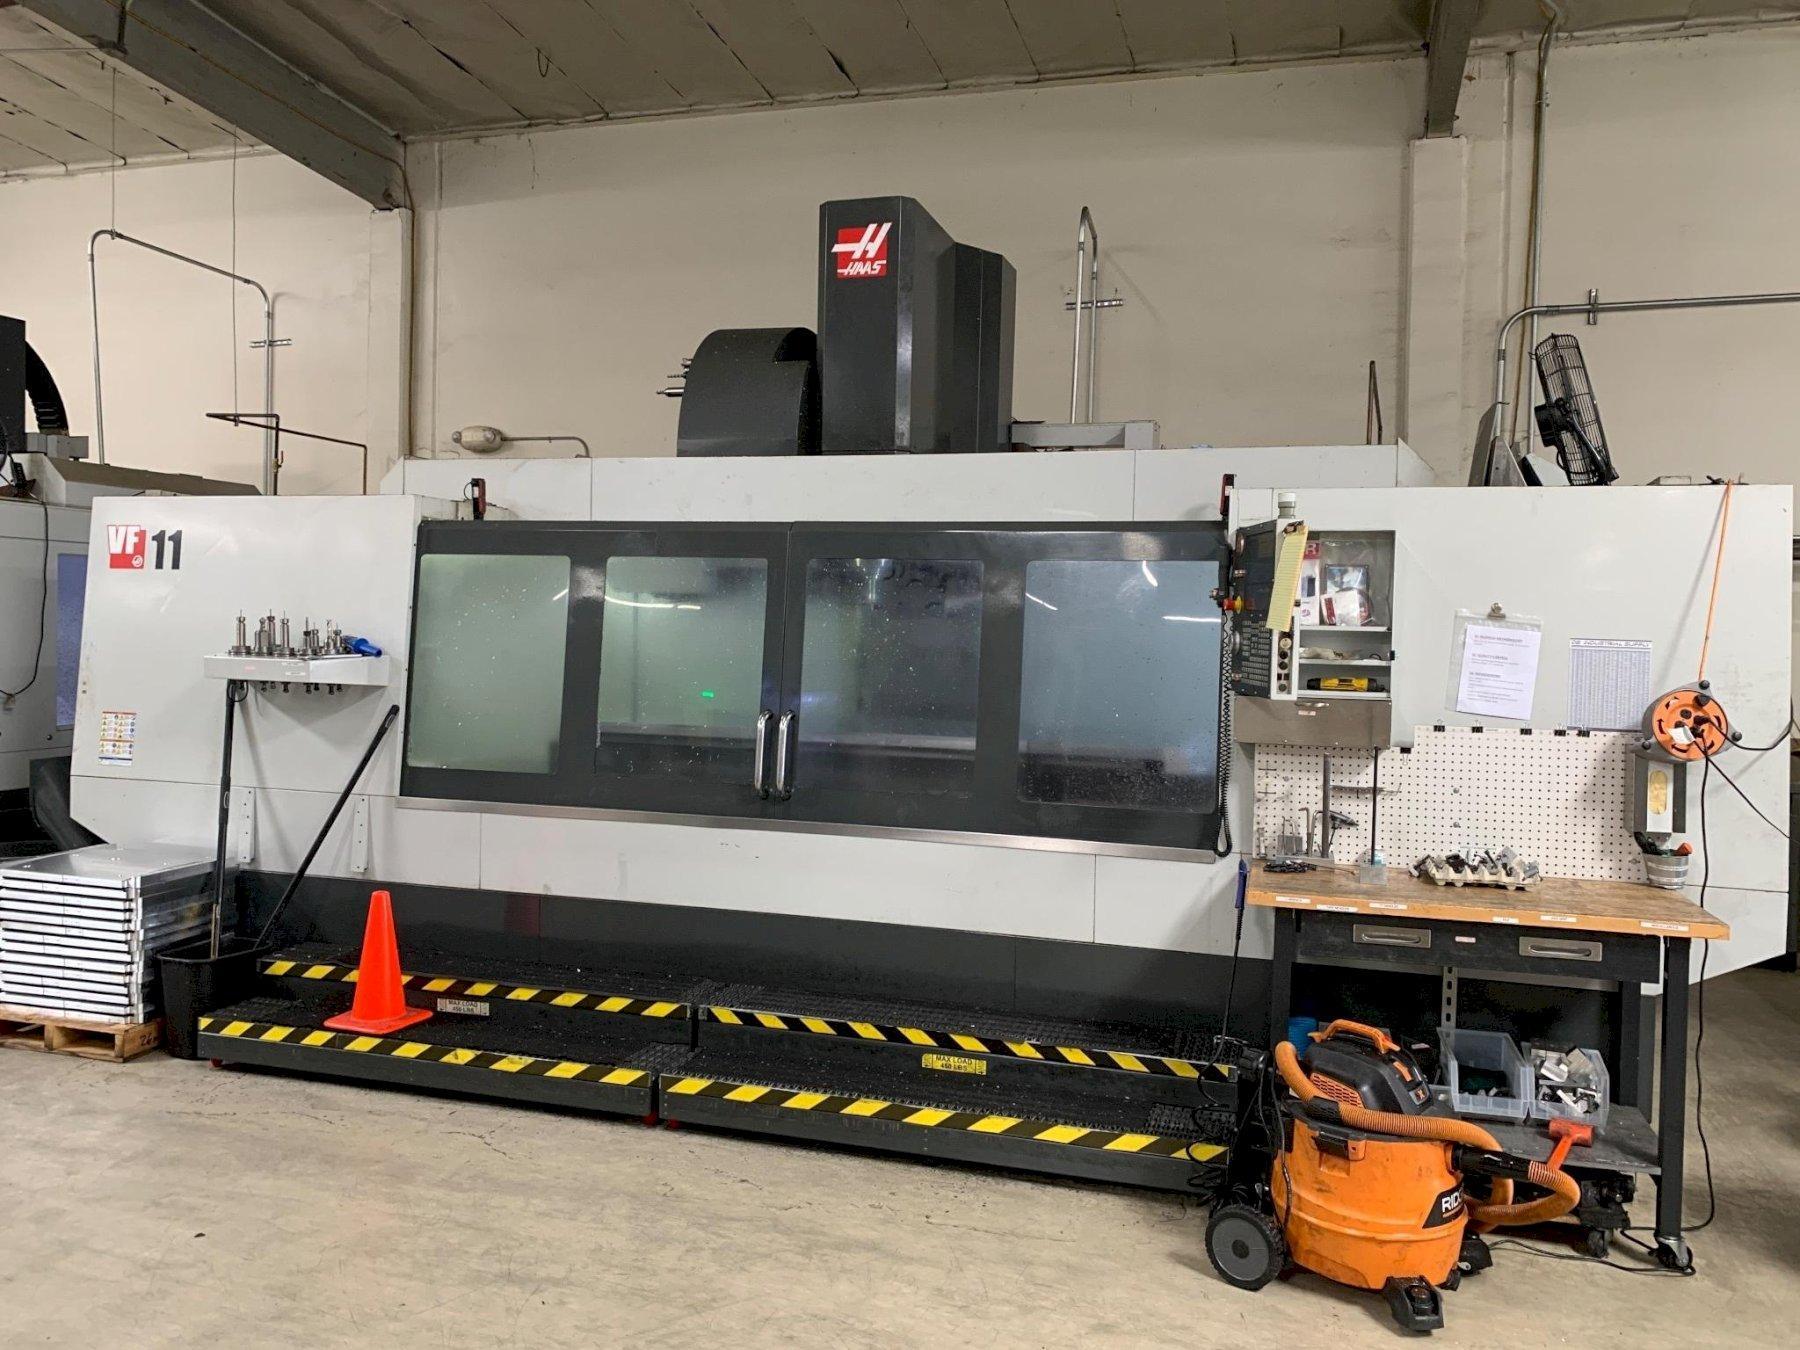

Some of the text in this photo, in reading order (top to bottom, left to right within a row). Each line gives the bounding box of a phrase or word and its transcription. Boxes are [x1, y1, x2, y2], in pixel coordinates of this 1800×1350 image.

[837, 260, 887, 275] HAAS
[107, 525, 183, 570] VF 11
[953, 1056, 973, 1065] LOAD
